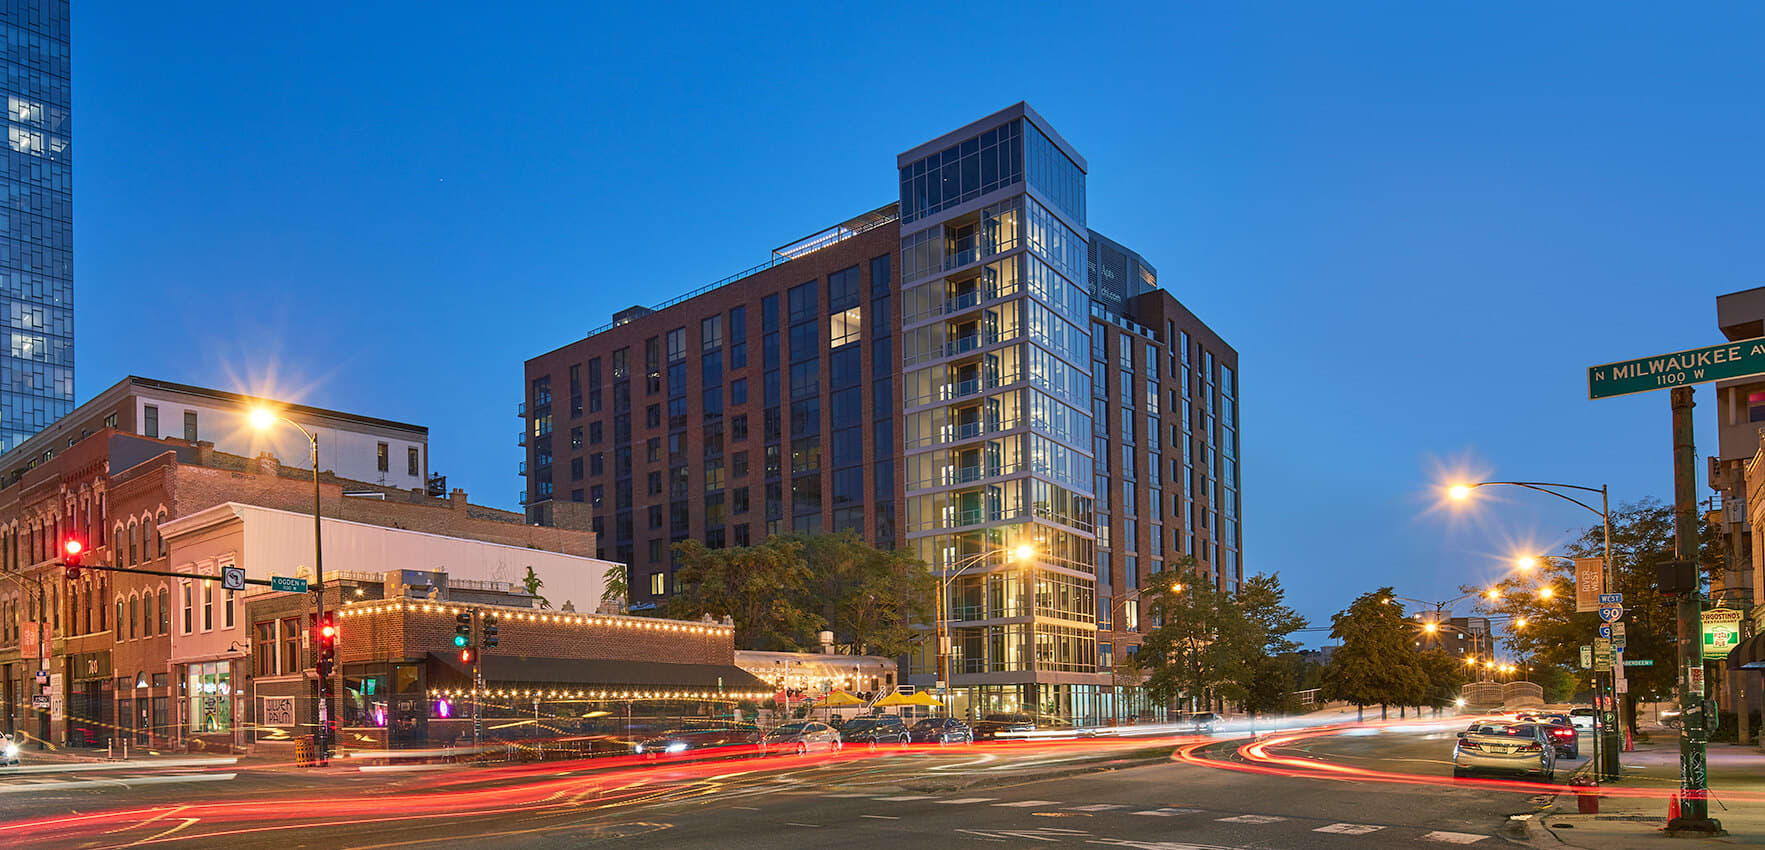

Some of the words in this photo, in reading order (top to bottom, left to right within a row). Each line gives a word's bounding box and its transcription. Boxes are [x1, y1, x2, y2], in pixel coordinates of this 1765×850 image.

[1595, 371, 1605, 381] N
[1613, 345, 1742, 381] MILWAUKEE
[1657, 371, 1686, 385] 1100
[1694, 368, 1705, 379] W
[277, 578, 300, 586] OGDEN
[1582, 568, 1591, 593] RIVER
[1590, 571, 1600, 592] WEST
[1602, 608, 1619, 619] 90
[1603, 629, 1611, 638] 9
